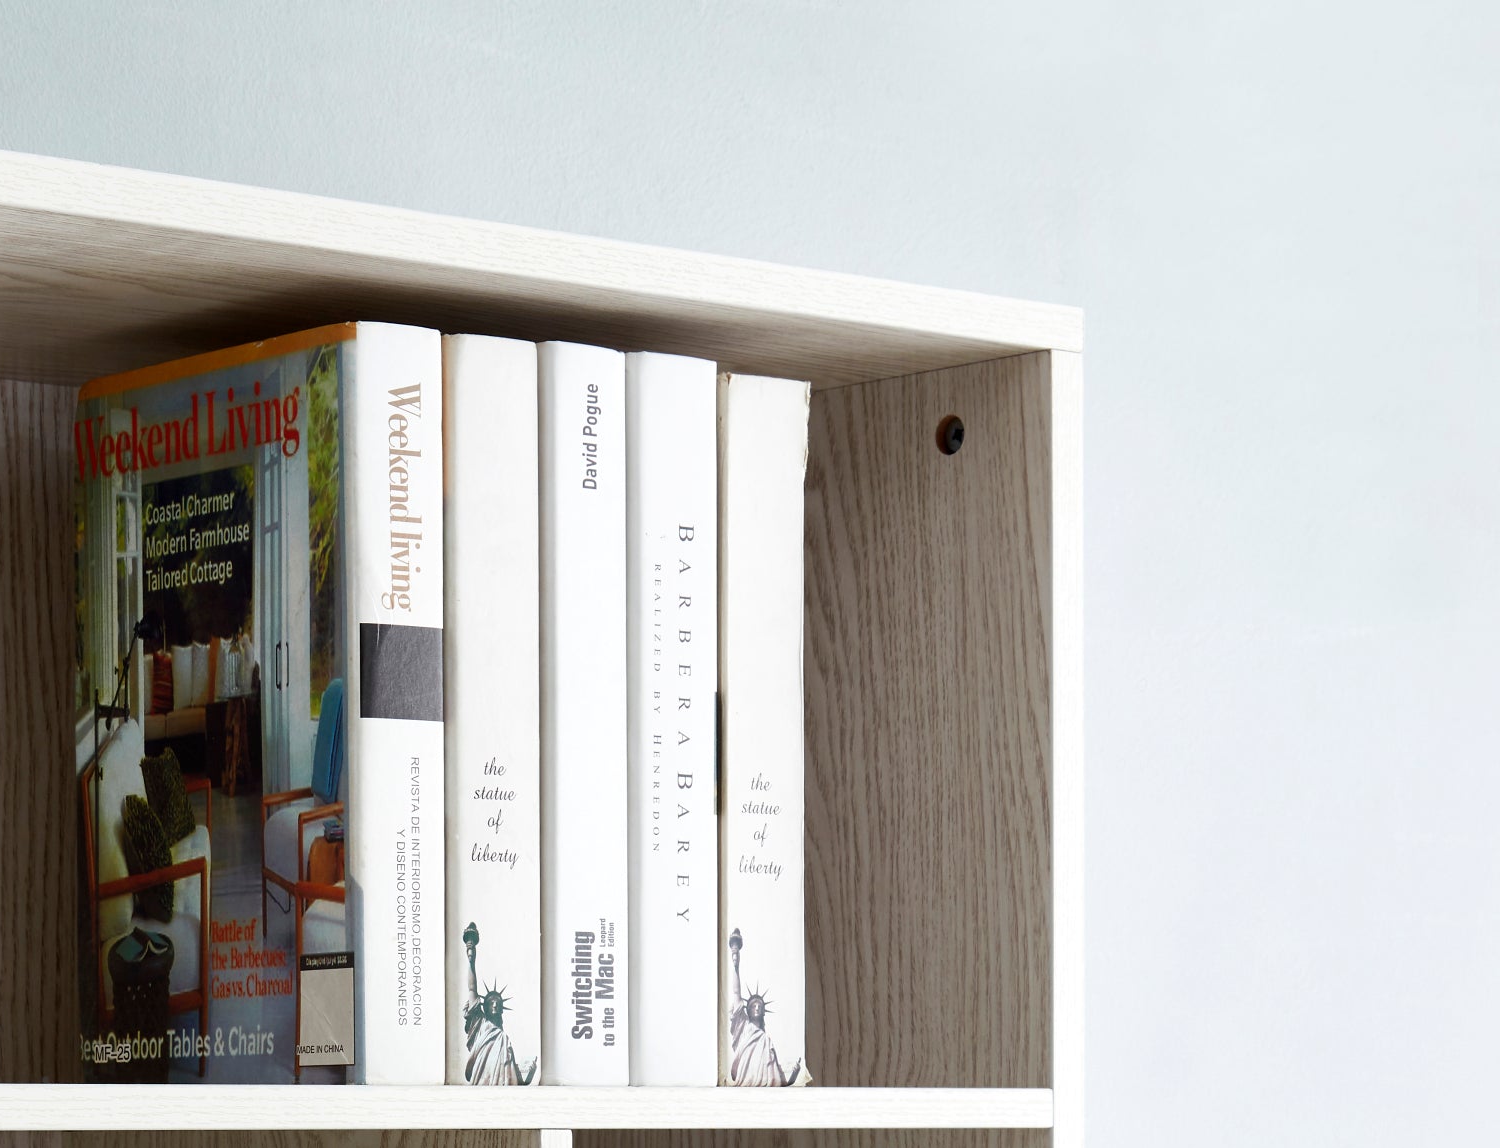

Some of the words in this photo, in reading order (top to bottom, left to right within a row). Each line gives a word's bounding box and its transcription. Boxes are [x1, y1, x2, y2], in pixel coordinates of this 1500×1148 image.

[582, 383, 601, 437] Pogue
[74, 393, 199, 483] Weekend
[205, 381, 300, 458] Living
[388, 383, 422, 524] Weekend
[582, 442, 598, 490] David
[146, 494, 185, 525] Coastal
[187, 491, 234, 516] Charmer
[146, 529, 187, 559] Modern
[189, 522, 249, 549] Farmhouse
[146, 563, 188, 591] Tailored
[190, 560, 233, 585] Cottage
[381, 530, 423, 610] living
[654, 563, 662, 673] REALIZED
[677, 524, 694, 745] BARBERA
[653, 691, 661, 714] BY
[484, 756, 506, 776] the
[751, 772, 771, 791] the
[410, 756, 419, 813] REVISTA
[474, 786, 516, 801] statue
[652, 734, 662, 853] HENREDON
[487, 808, 504, 834] of
[741, 801, 781, 815] statue
[411, 817, 420, 834] DE
[753, 823, 767, 847] of
[471, 842, 519, 870] liberty
[676, 771, 694, 922] BAREY
[739, 855, 783, 881] liberty
[211, 920, 241, 943] Battle
[243, 918, 257, 940] of
[211, 948, 228, 970] the
[397, 895, 407, 1026] CONTEMPORANEOS
[211, 978, 231, 999] Gas
[246, 971, 293, 998] Charcoal
[571, 931, 595, 1039] Switching
[595, 954, 614, 1000] Mac
[602, 1008, 615, 1029] the
[167, 1028, 211, 1057] Tables
[214, 1027, 225, 1056] &
[228, 1025, 274, 1056] Chairs
[297, 1046, 314, 1054] MADE
[316, 1045, 323, 1054] IN
[324, 1045, 344, 1053] CHINA
[603, 1034, 615, 1046] to
